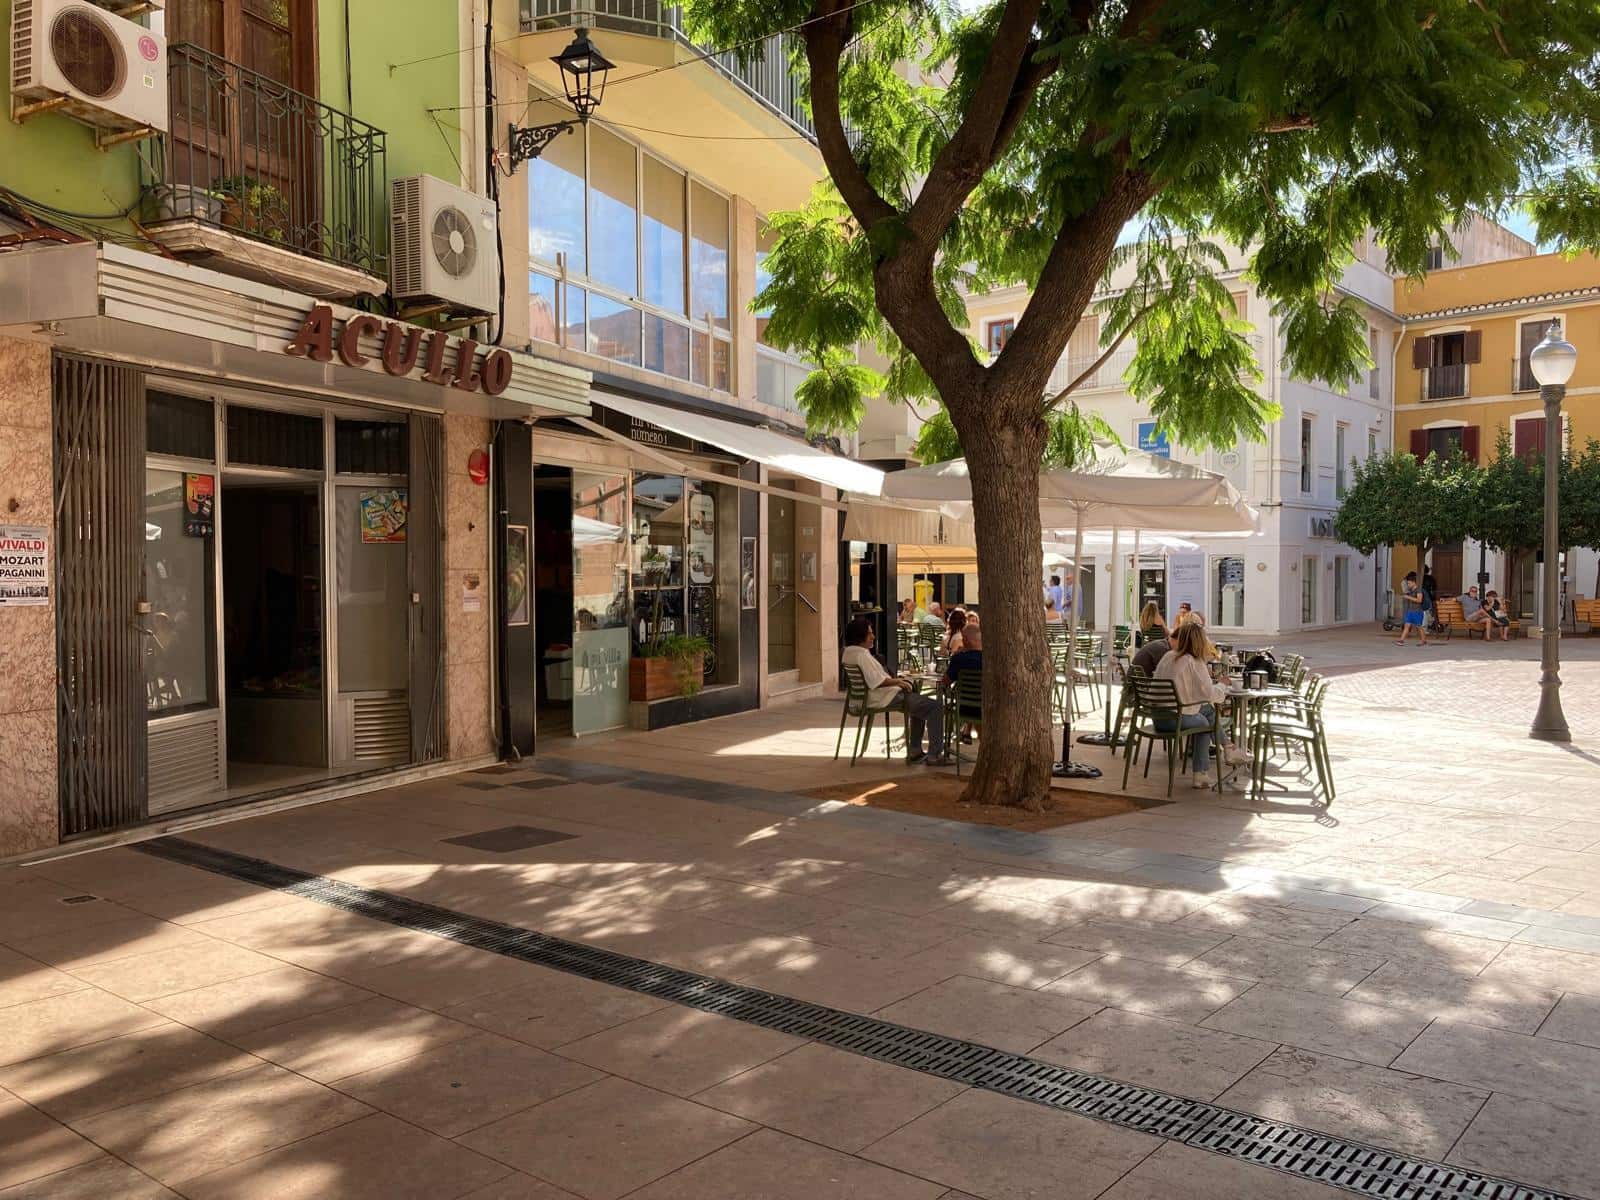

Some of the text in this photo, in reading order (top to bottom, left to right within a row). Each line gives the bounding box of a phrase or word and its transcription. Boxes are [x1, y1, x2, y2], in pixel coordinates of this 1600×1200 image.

[283, 300, 512, 395] ACULLO
[0, 540, 45, 551] VIVALDI
[0, 556, 45, 566] MOZART
[0, 569, 45, 577] PAGANINI
